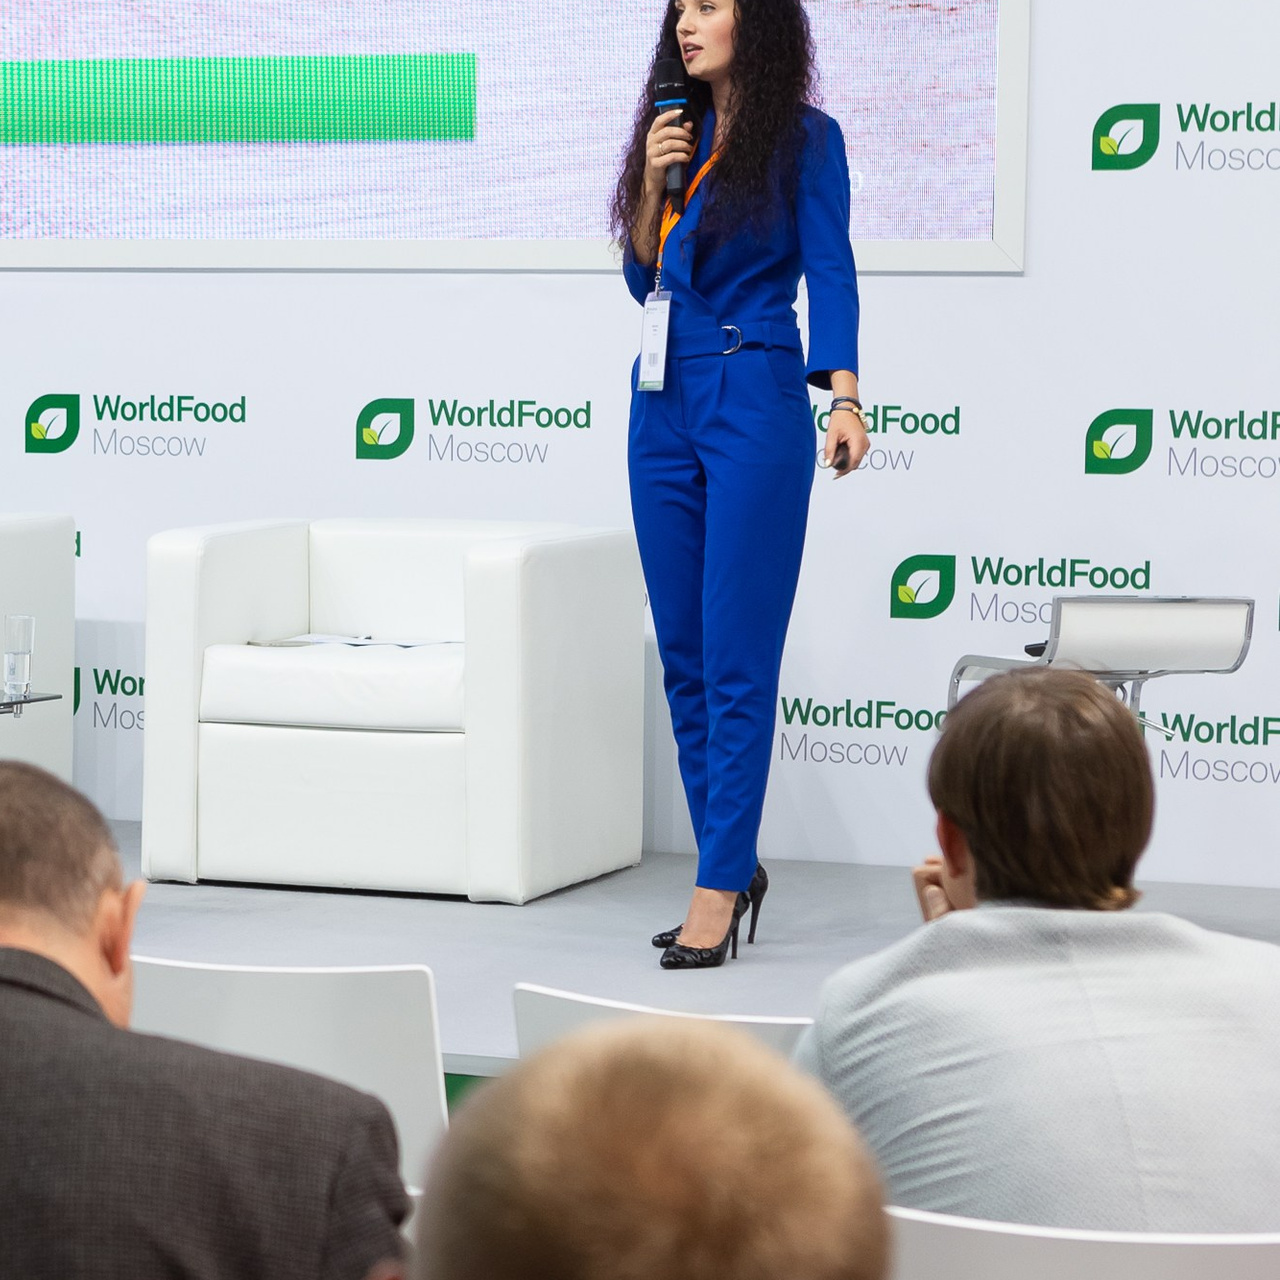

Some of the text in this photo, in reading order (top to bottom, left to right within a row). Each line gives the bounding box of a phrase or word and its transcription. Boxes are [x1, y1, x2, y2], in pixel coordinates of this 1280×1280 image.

[1177, 102, 1280, 132] World
[93, 395, 245, 422] WorldFood
[429, 399, 591, 428] WorldFood
[94, 428, 206, 456] Moscow
[429, 434, 548, 463] Moscow
[1169, 447, 1280, 478] Mosco
[971, 556, 1150, 589] WorldFood
[970, 592, 1052, 625] Mosc
[781, 732, 907, 765] Moscow
